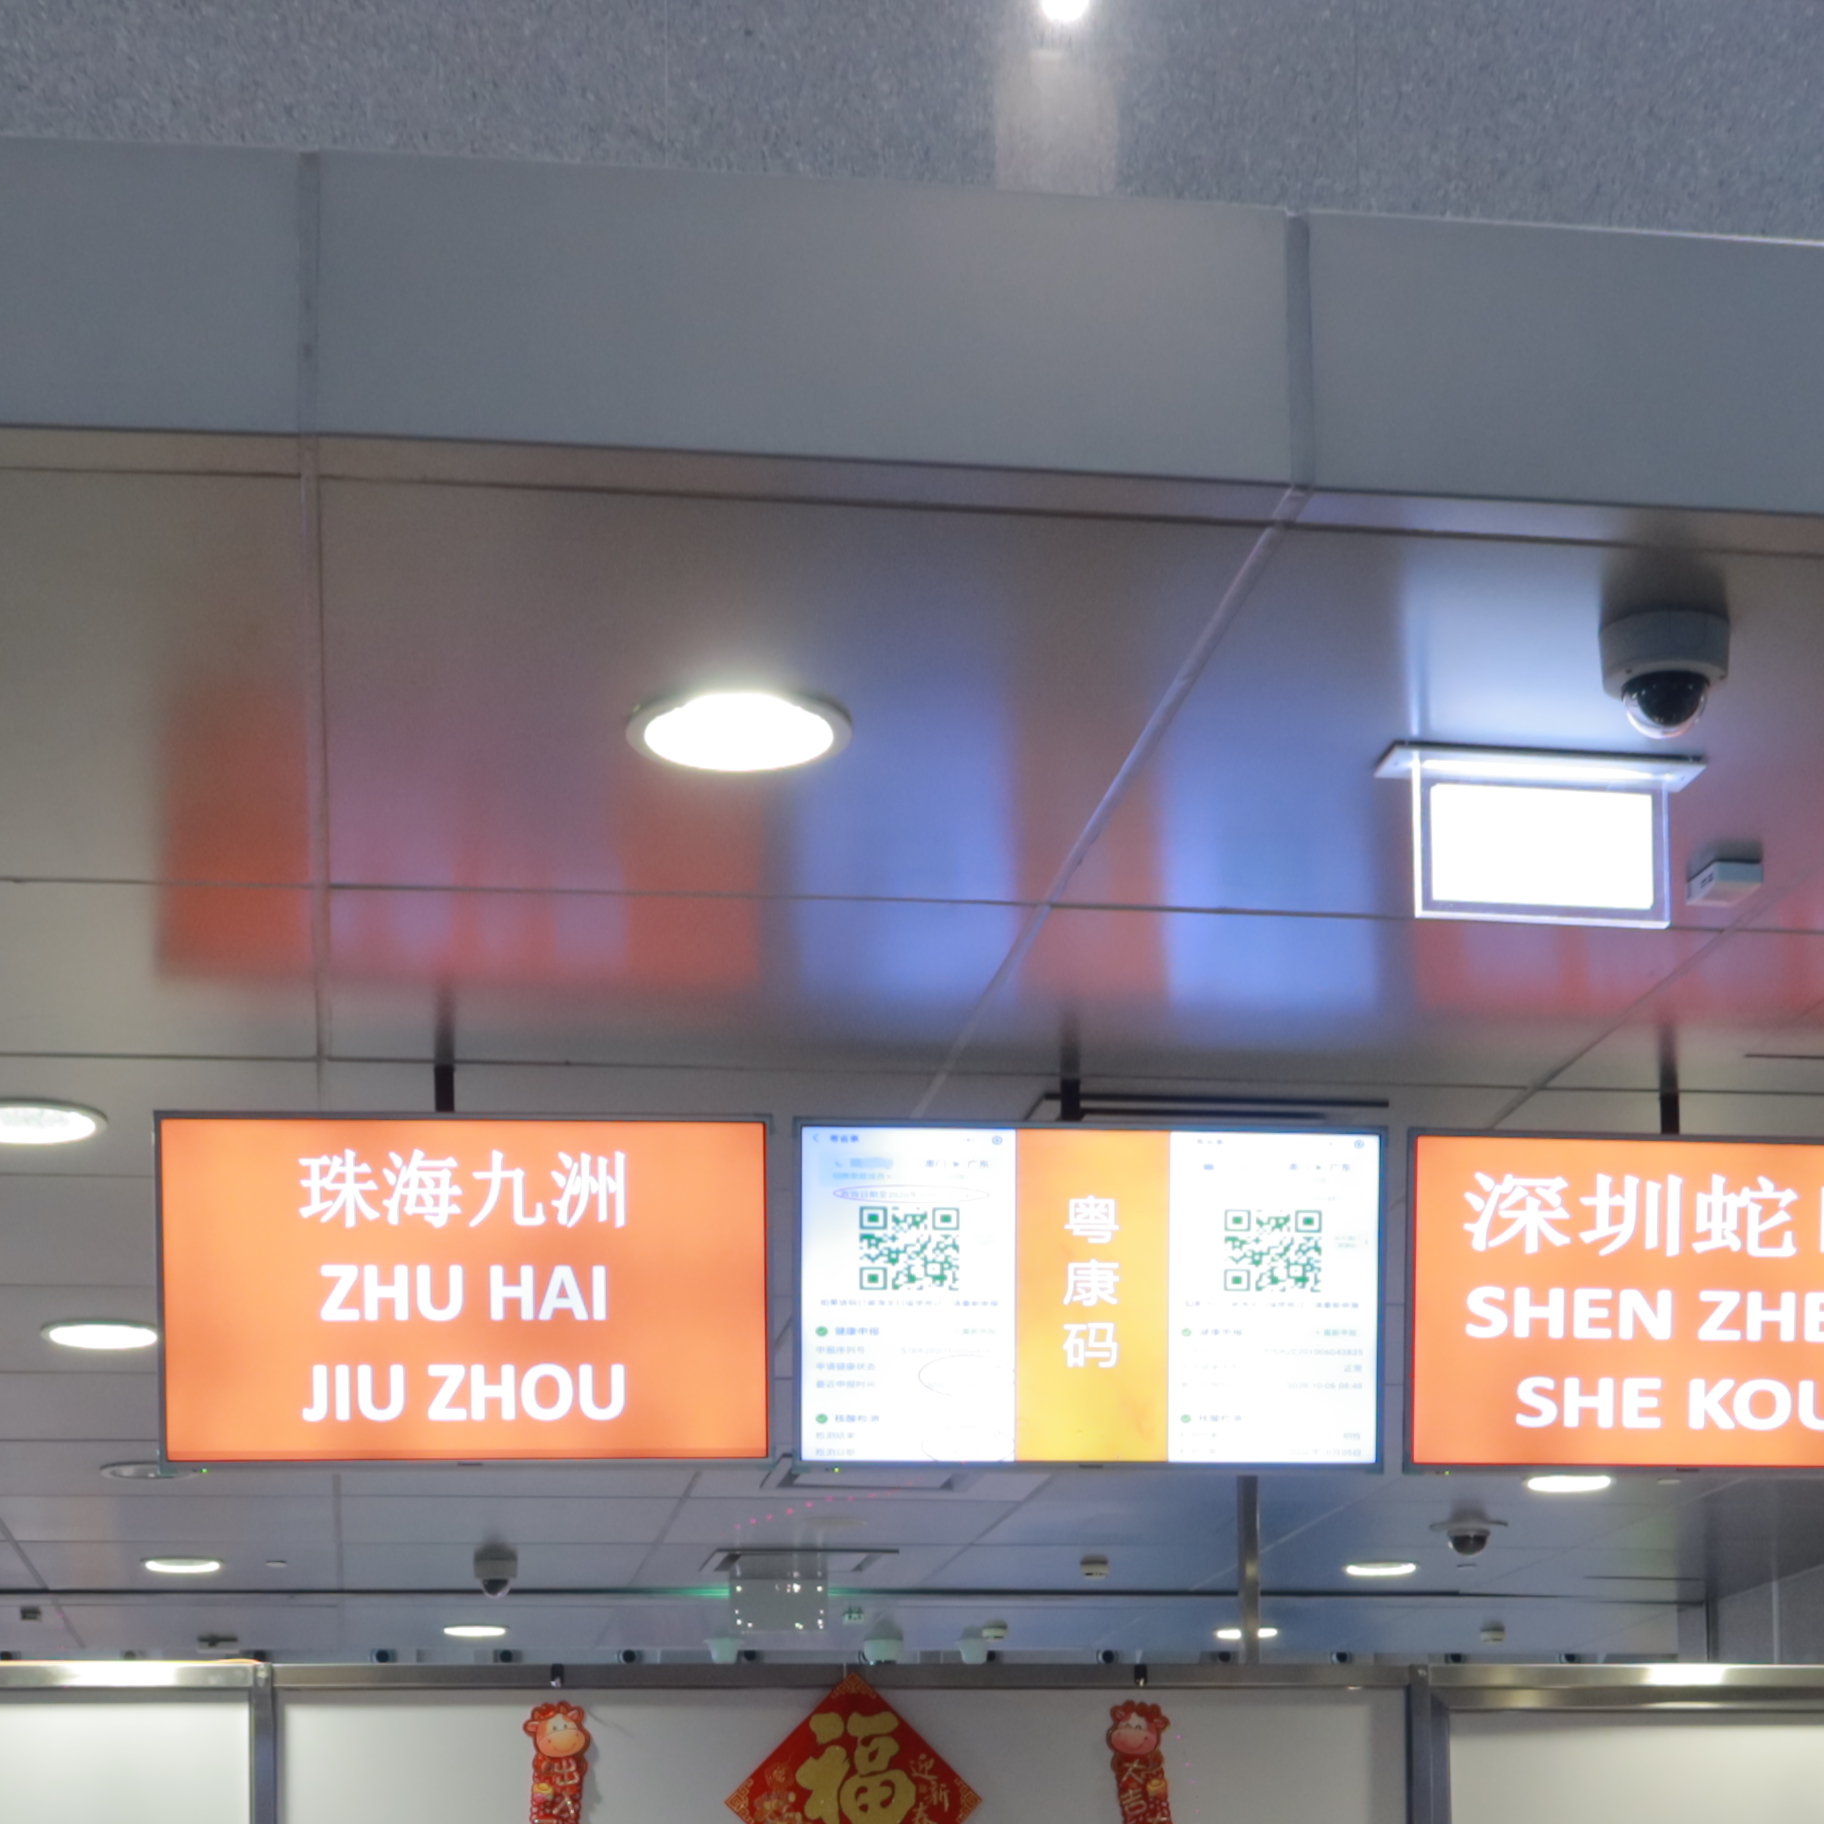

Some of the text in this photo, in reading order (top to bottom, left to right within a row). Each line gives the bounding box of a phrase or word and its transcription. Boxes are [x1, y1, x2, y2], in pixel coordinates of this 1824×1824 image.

[298, 1149, 627, 1228] 珠海九洲
[320, 1265, 607, 1321] ZHU HAI
[1062, 1194, 1120, 1369] 粤康码
[1465, 1286, 1673, 1341] SHEN
[302, 1363, 625, 1422] JIU ZHOU
[1515, 1376, 1662, 1429] SHE
